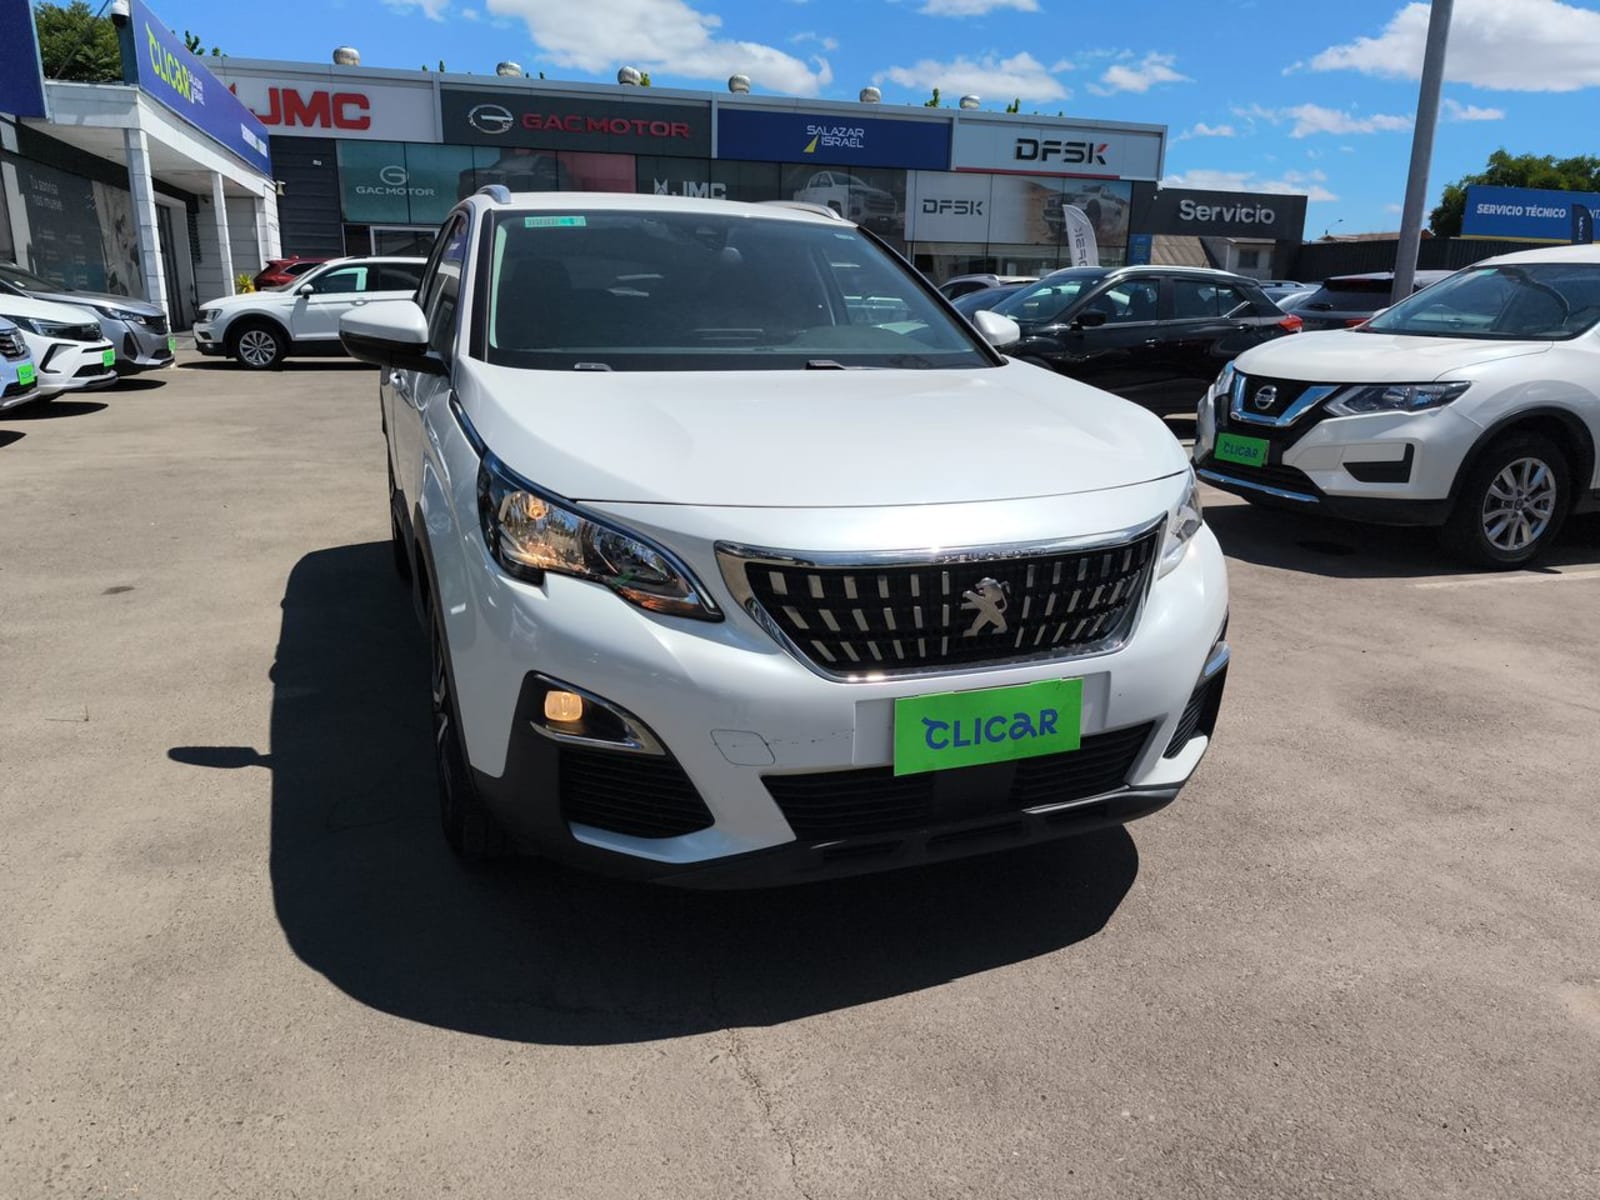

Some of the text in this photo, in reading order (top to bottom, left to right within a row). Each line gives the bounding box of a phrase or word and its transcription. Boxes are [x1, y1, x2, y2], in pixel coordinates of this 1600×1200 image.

[250, 88, 371, 131] JMC
[521, 113, 690, 138] GAC MOTOR
[806, 125, 865, 138] SALAZAR
[821, 136, 865, 148] ISRAEL
[1014, 138, 1109, 165] DFSK
[355, 186, 436, 197] GAC MOTOR
[922, 199, 983, 216] DFSK
[1179, 199, 1276, 225] Servicio
[1476, 203, 1567, 219] SERVICIO TÉCNICO
